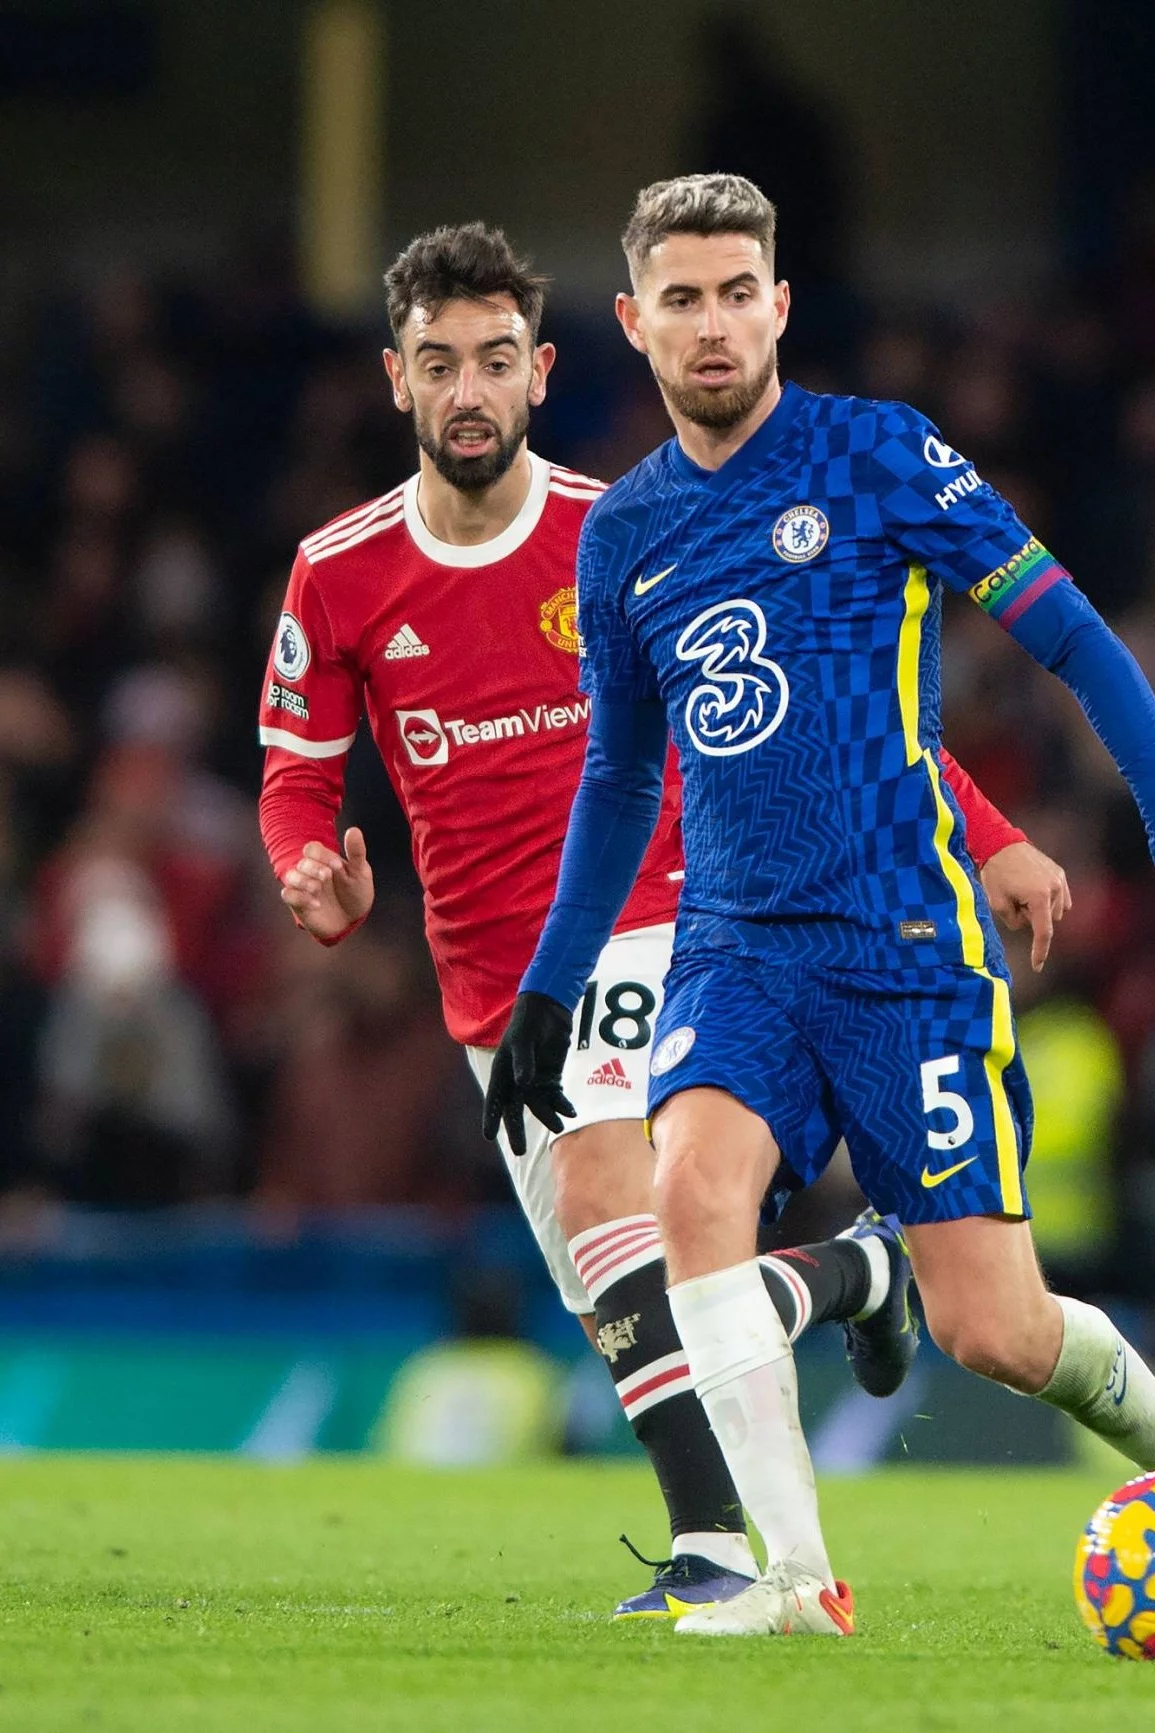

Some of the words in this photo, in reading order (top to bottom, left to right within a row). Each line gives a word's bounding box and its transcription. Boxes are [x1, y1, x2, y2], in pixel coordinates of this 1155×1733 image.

[782, 508, 818, 522] CHELSEA
[545, 591, 575, 616] MANCH
[384, 644, 431, 661] adidas
[557, 638, 577, 649] UNI
[676, 599, 789, 757] 3
[281, 687, 305, 707] room
[281, 697, 309, 720] racism
[444, 698, 592, 746] TeamView
[577, 980, 656, 1051] 18
[587, 1074, 632, 1090] adidas
[920, 1054, 974, 1150] 5
